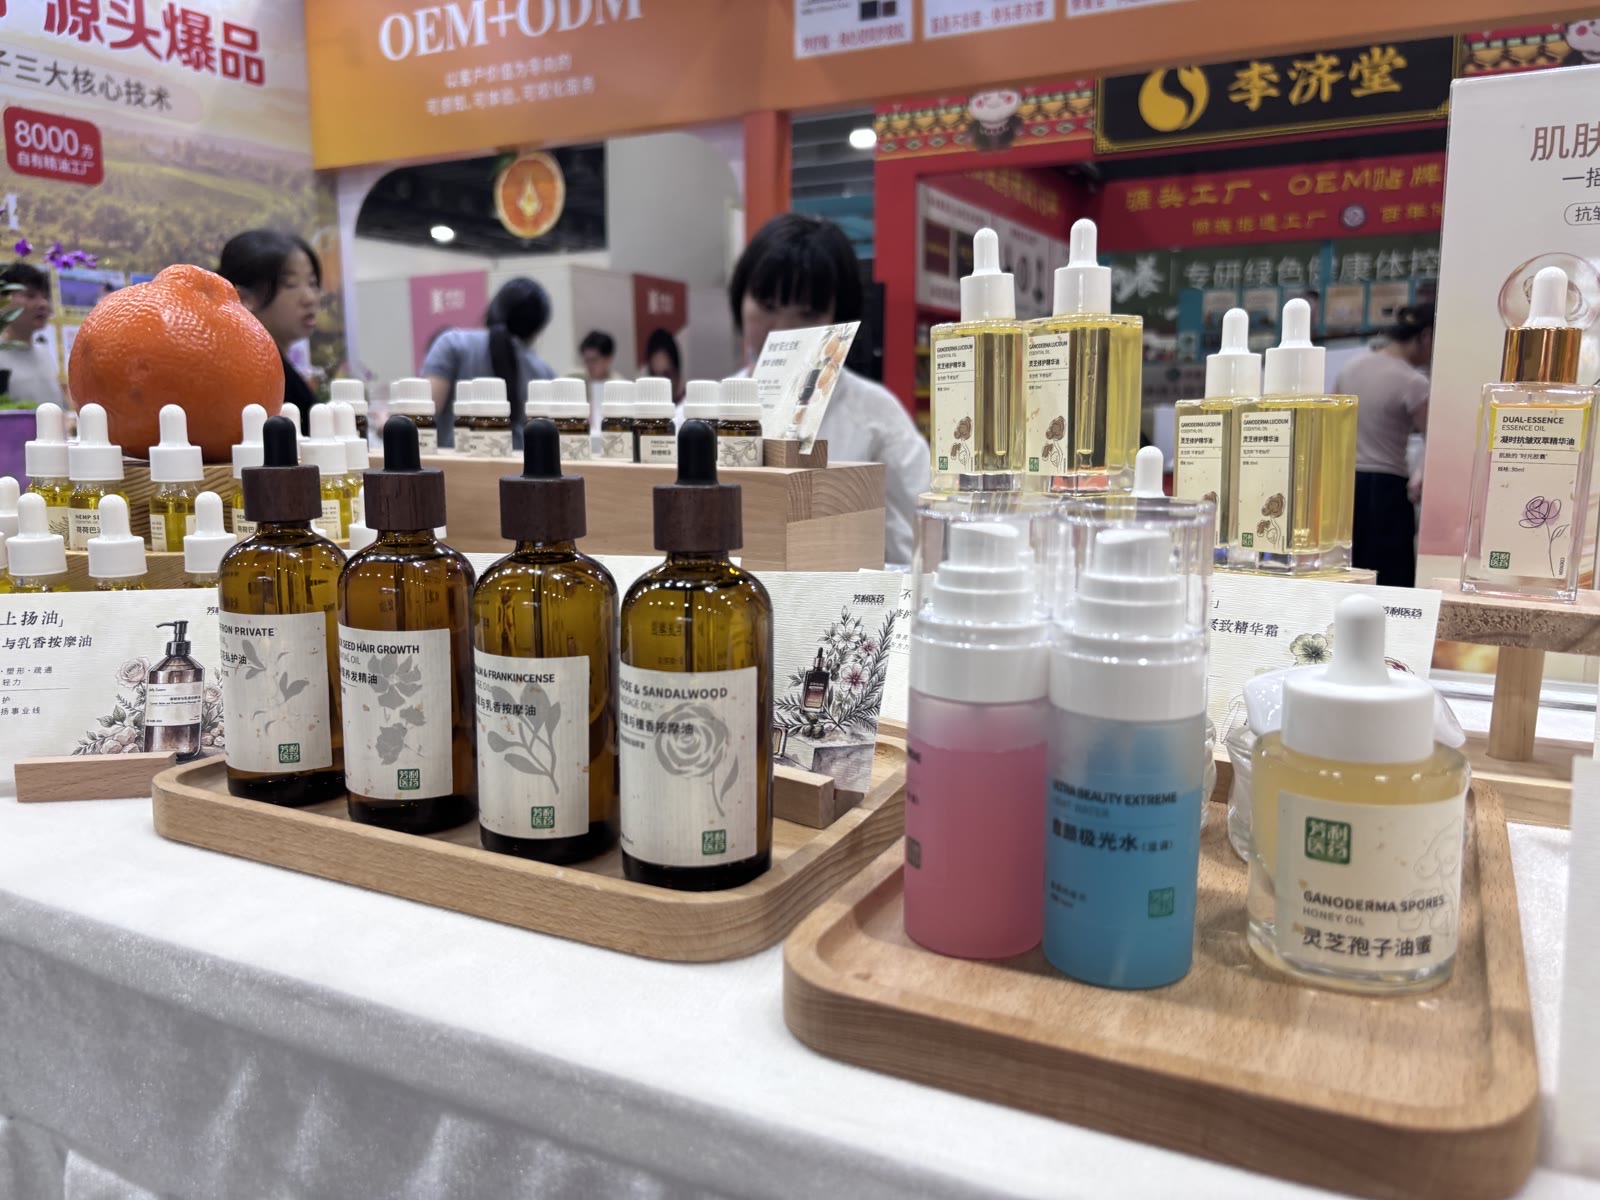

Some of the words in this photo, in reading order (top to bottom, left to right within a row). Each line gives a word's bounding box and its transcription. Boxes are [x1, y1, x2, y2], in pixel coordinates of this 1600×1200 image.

[43, 0, 266, 87] 源头爆品
[1227, 46, 1408, 112] 李济堂
[1502, 415, 1564, 425] DUAL-ESSENCE
[1501, 424, 1533, 432] ESSENCE
[234, 626, 275, 637] PRIVATE
[2, 635, 92, 650] 与乳香按摩油
[356, 642, 376, 654] HAIR
[376, 645, 420, 655] GROWTH
[488, 669, 556, 684] FRANKINCENSE
[633, 684, 641, 695] &
[642, 685, 728, 700] SANDALWOOD
[1077, 787, 1122, 805] BEAUTY
[1124, 791, 1177, 806] EXTREME
[1302, 889, 1397, 914] GANODERMA
[1399, 894, 1445, 914] SPORES
[1302, 906, 1343, 924] HONEY
[1344, 913, 1366, 927] OIL
